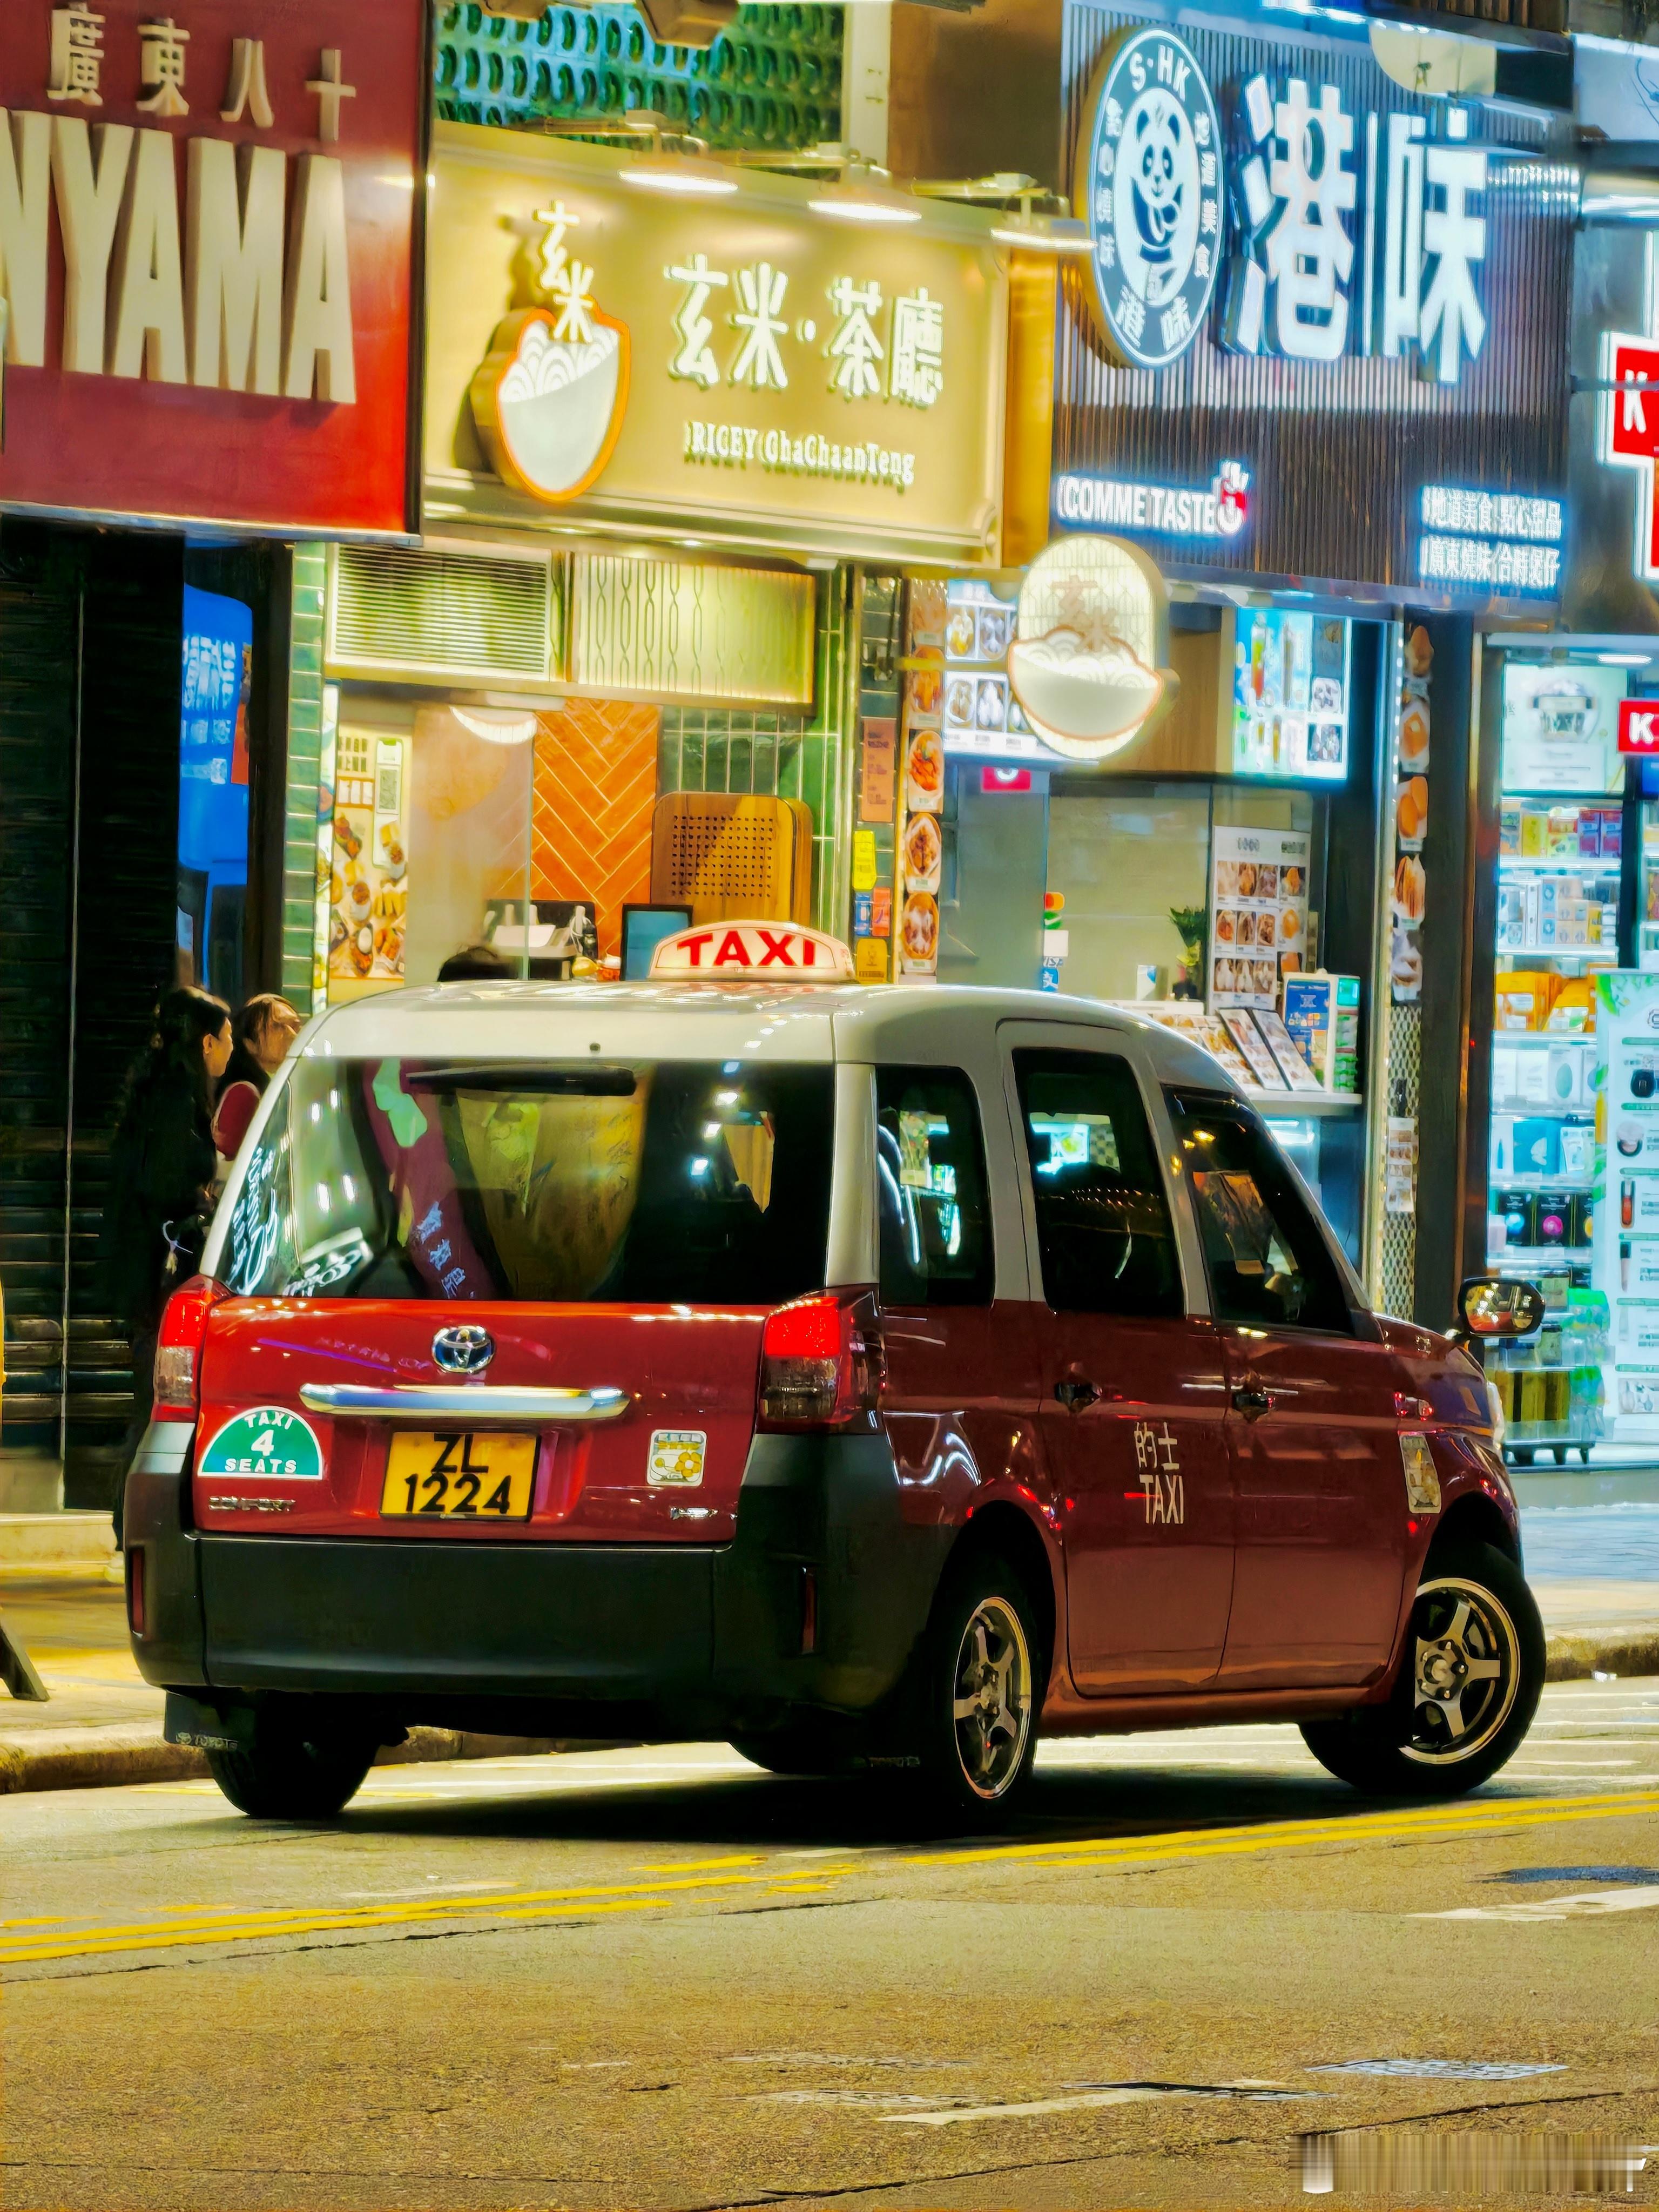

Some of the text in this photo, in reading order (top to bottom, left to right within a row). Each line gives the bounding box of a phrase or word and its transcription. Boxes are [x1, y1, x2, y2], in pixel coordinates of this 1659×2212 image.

[1244, 74, 1487, 383] 港味
[534, 200, 594, 342] 玄米
[690, 421, 758, 460] RICEY
[1064, 475, 1146, 526] COMME
[1629, 711, 1654, 744] K
[677, 930, 817, 967] TAXI
[244, 1411, 295, 1430] TAXI
[251, 1429, 274, 1457] 4
[431, 1433, 489, 1474] ZL
[1134, 1421, 1180, 1471] 的士
[224, 1458, 297, 1474] SEATS
[404, 1473, 512, 1514] 1224
[1139, 1474, 1184, 1525] TAXI
